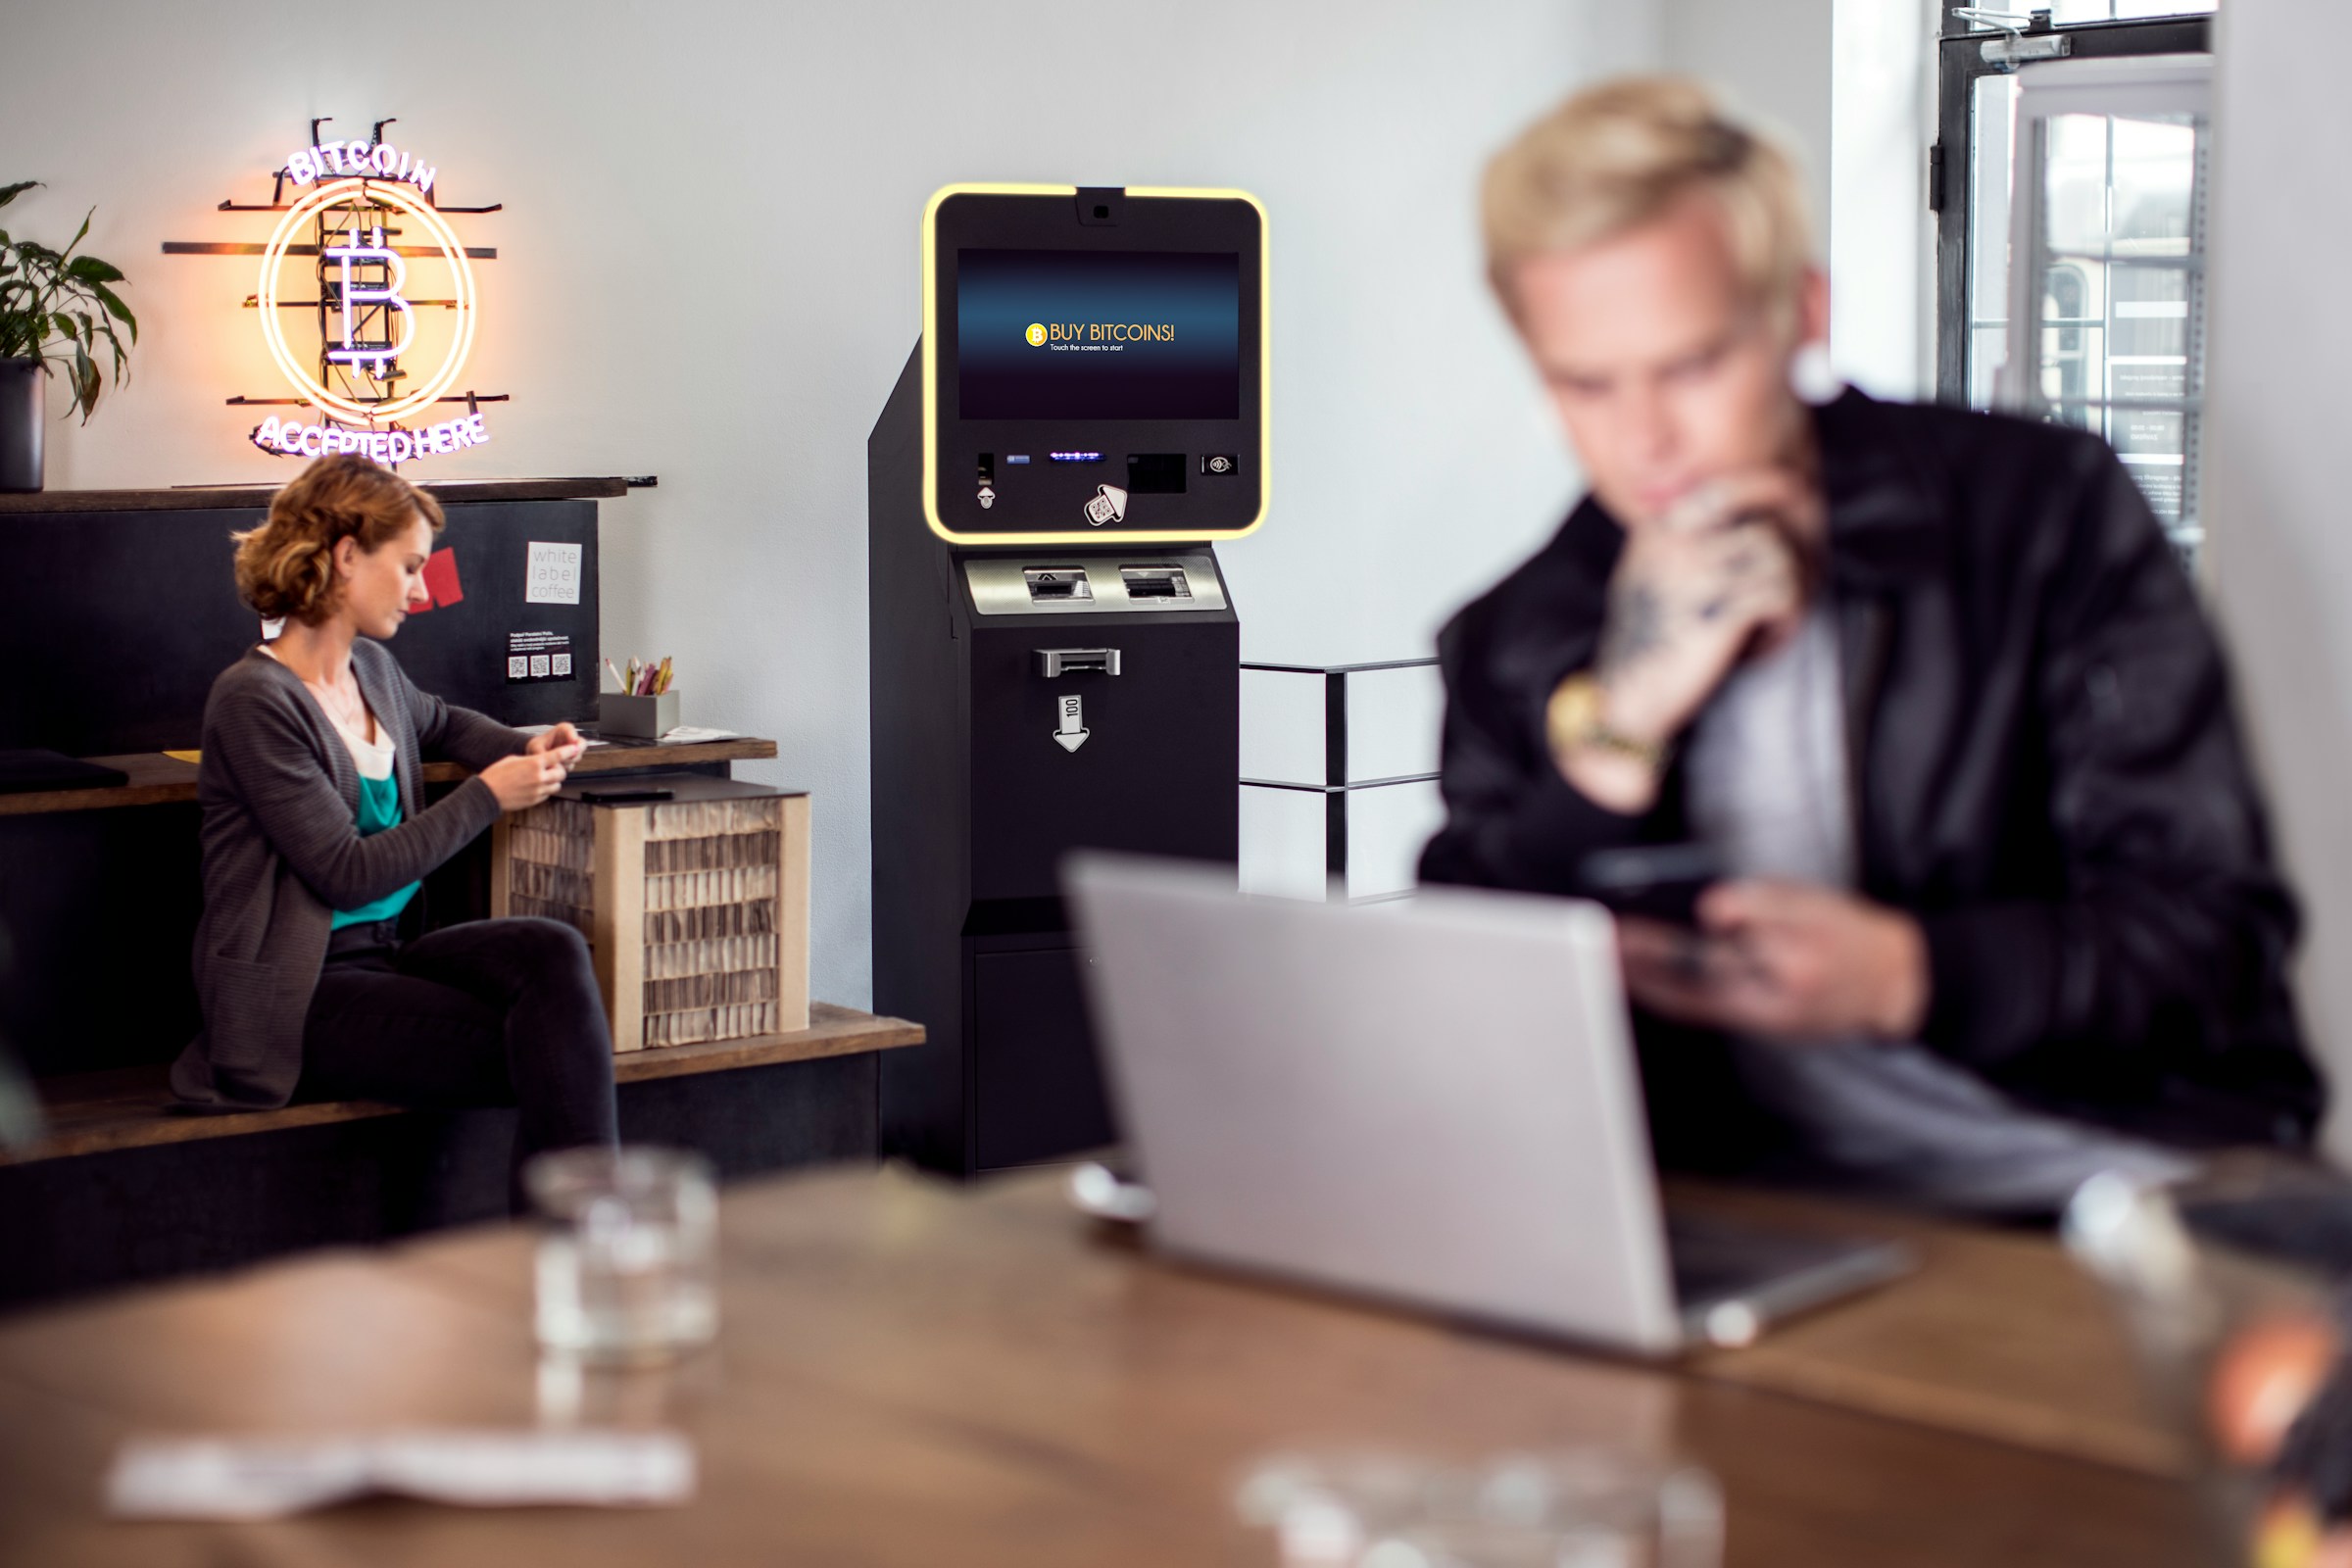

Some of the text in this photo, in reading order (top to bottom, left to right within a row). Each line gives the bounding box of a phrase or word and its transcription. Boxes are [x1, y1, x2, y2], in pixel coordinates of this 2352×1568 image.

[287, 140, 436, 192] BITCOIN
[1050, 323, 1175, 341] BUY BITCOINS!
[255, 413, 489, 464] ACCEPTED HERE
[533, 549, 577, 564] white
[532, 564, 576, 581] label
[531, 583, 574, 599] coffee
[1066, 700, 1078, 717] 100
